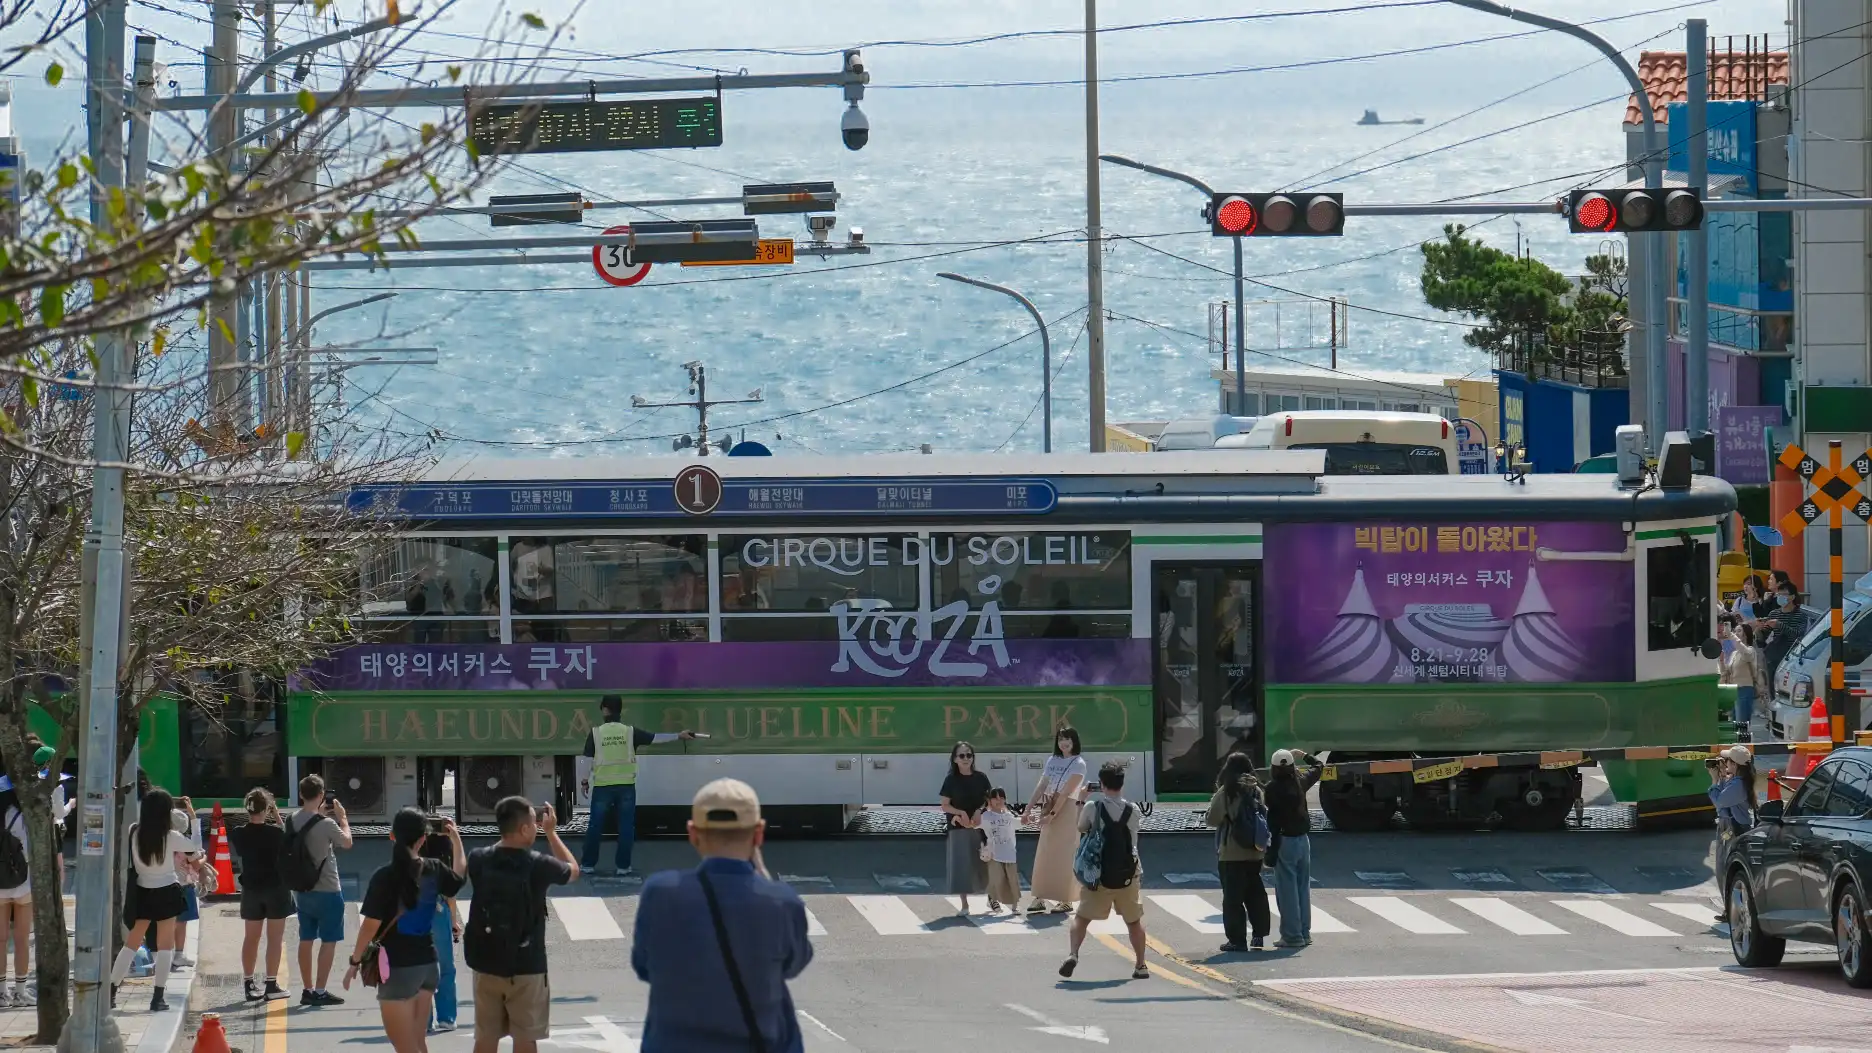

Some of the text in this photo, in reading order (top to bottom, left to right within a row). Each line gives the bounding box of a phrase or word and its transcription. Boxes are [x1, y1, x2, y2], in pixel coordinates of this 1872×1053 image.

[607, 245, 637, 268] 30
[756, 243, 788, 261] 속장비
[434, 491, 472, 505] 구덕포
[511, 490, 573, 504] 다릿돌전망대
[610, 489, 648, 503] 청사포
[688, 473, 705, 507] 1
[748, 487, 803, 502] 해월전망대
[877, 487, 932, 501] 달맞이터널
[1006, 486, 1027, 499] 미포
[1355, 526, 1538, 553] 빅탑이 돌아왔다
[742, 537, 889, 576] CIRQUE
[902, 536, 954, 566] DU
[1386, 569, 1513, 589] 태양의서커스 쿠자
[360, 645, 597, 681] 태양의서커스 쿠자
[1410, 647, 1488, 663] 8.21-9.28
[1393, 664, 1507, 678] 신세계 센텀시티 내 빅탑
[661, 706, 897, 740] BLUELINE
[942, 704, 1077, 740] PARK
[1427, 765, 1461, 779] 일단정지
